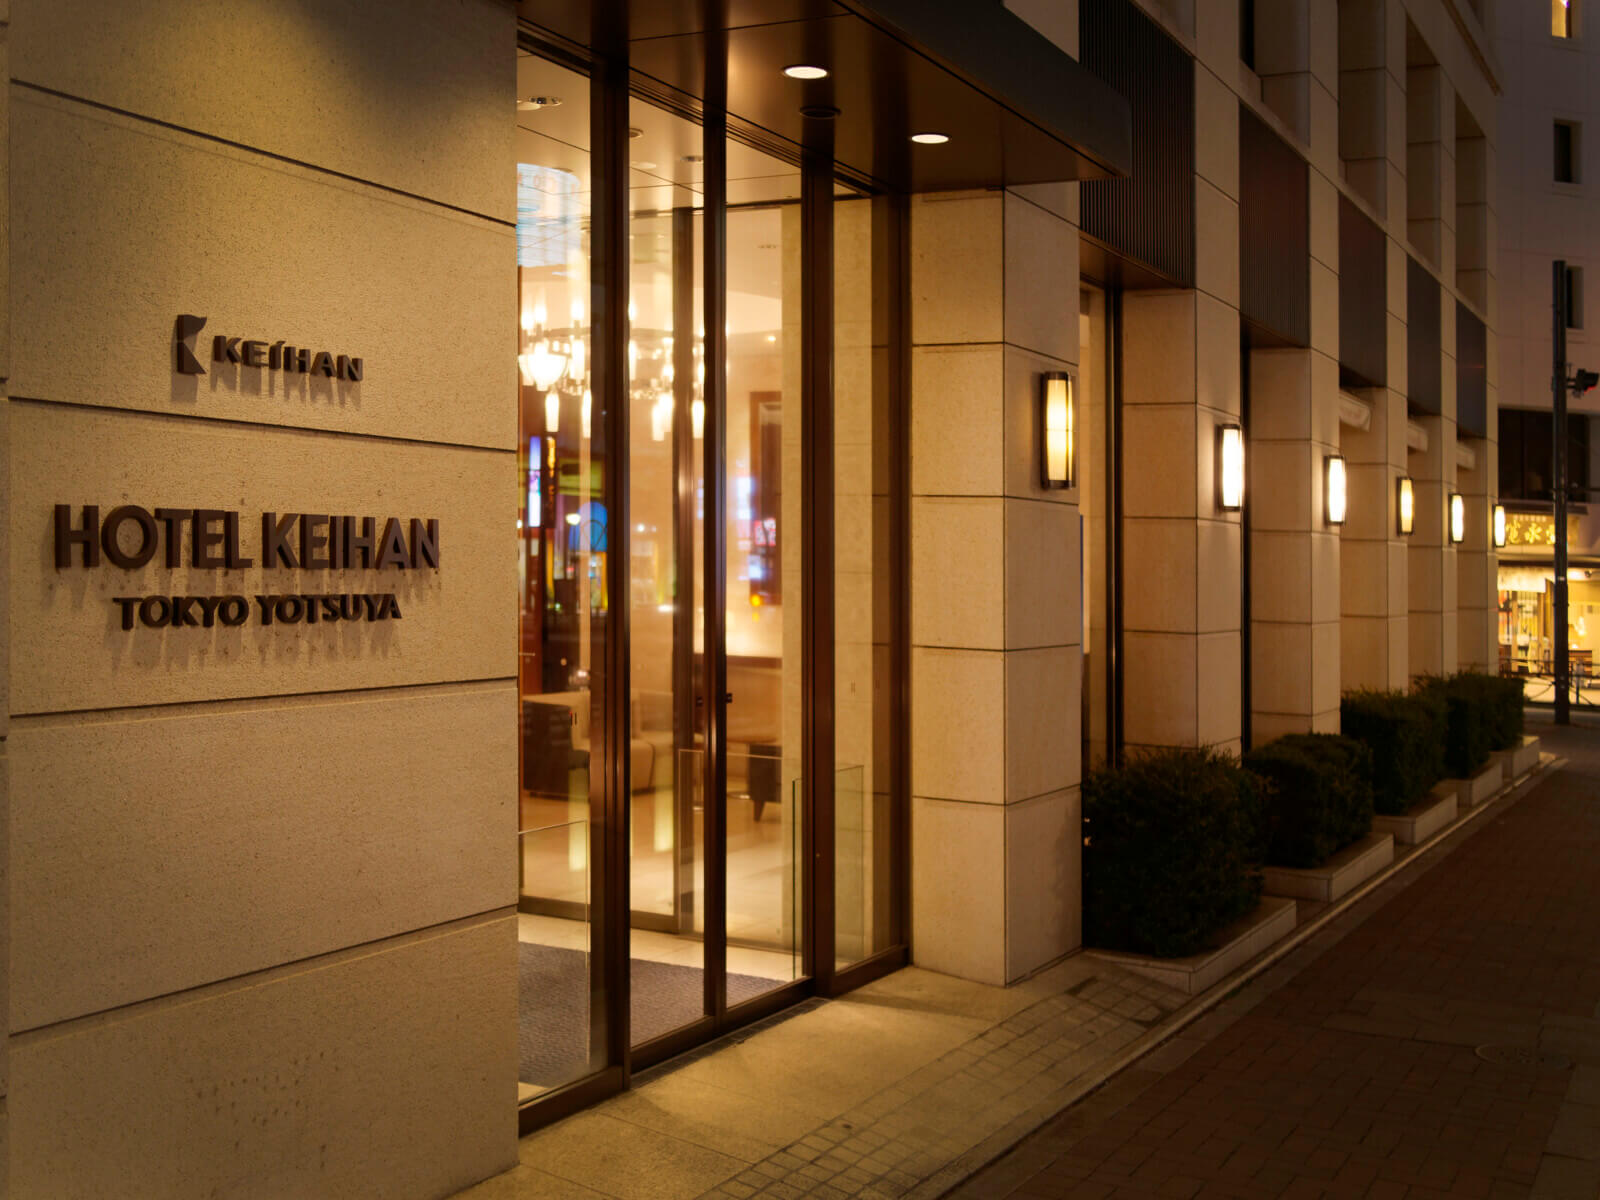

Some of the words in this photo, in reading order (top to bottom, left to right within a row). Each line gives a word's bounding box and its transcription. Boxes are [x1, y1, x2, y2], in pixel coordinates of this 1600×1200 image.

[54, 504, 254, 570] HOTEL
[261, 511, 440, 569] KEIHAN
[112, 595, 250, 631] TOKYO
[254, 593, 402, 626] YOTSUYA
